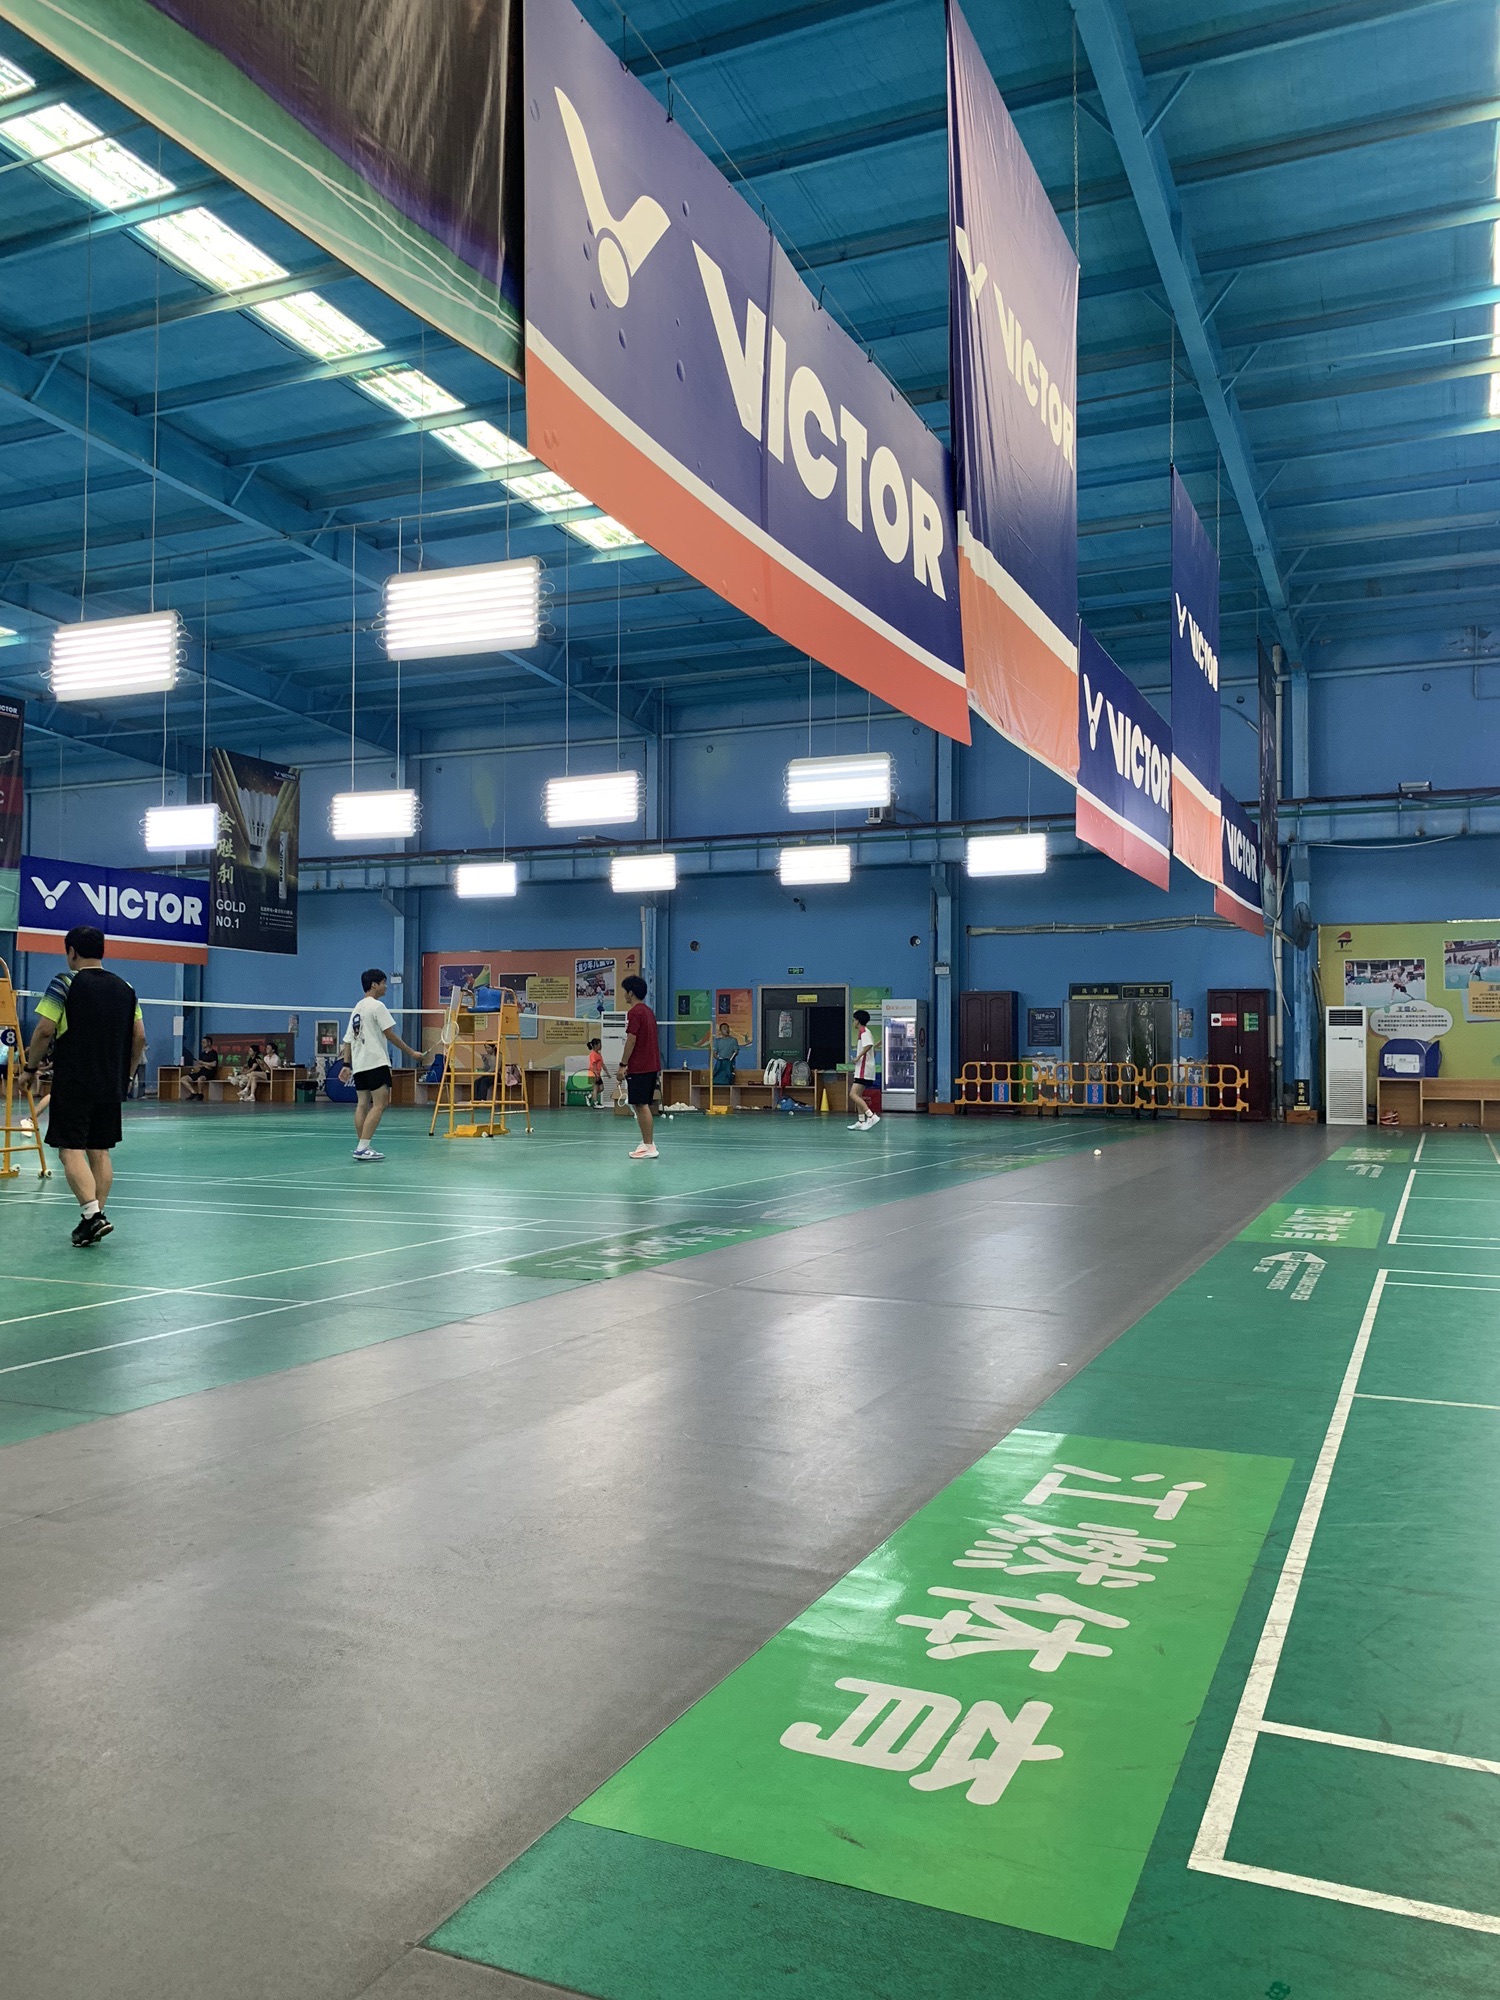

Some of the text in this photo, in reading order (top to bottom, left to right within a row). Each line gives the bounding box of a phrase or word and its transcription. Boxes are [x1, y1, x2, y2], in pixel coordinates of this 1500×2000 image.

[992, 281, 1076, 470] VICTOR
[692, 239, 947, 601] VICTOR
[1188, 612, 1219, 693] VICTOR
[1106, 700, 1170, 814] VICTOR
[1225, 817, 1258, 883] VICTOR
[78, 881, 203, 926] VICTOR
[216, 898, 247, 914] GOLD
[216, 916, 240, 929] NO.1
[6, 1031, 15, 1044] 8
[780, 1463, 1207, 1806] 江燃体育
